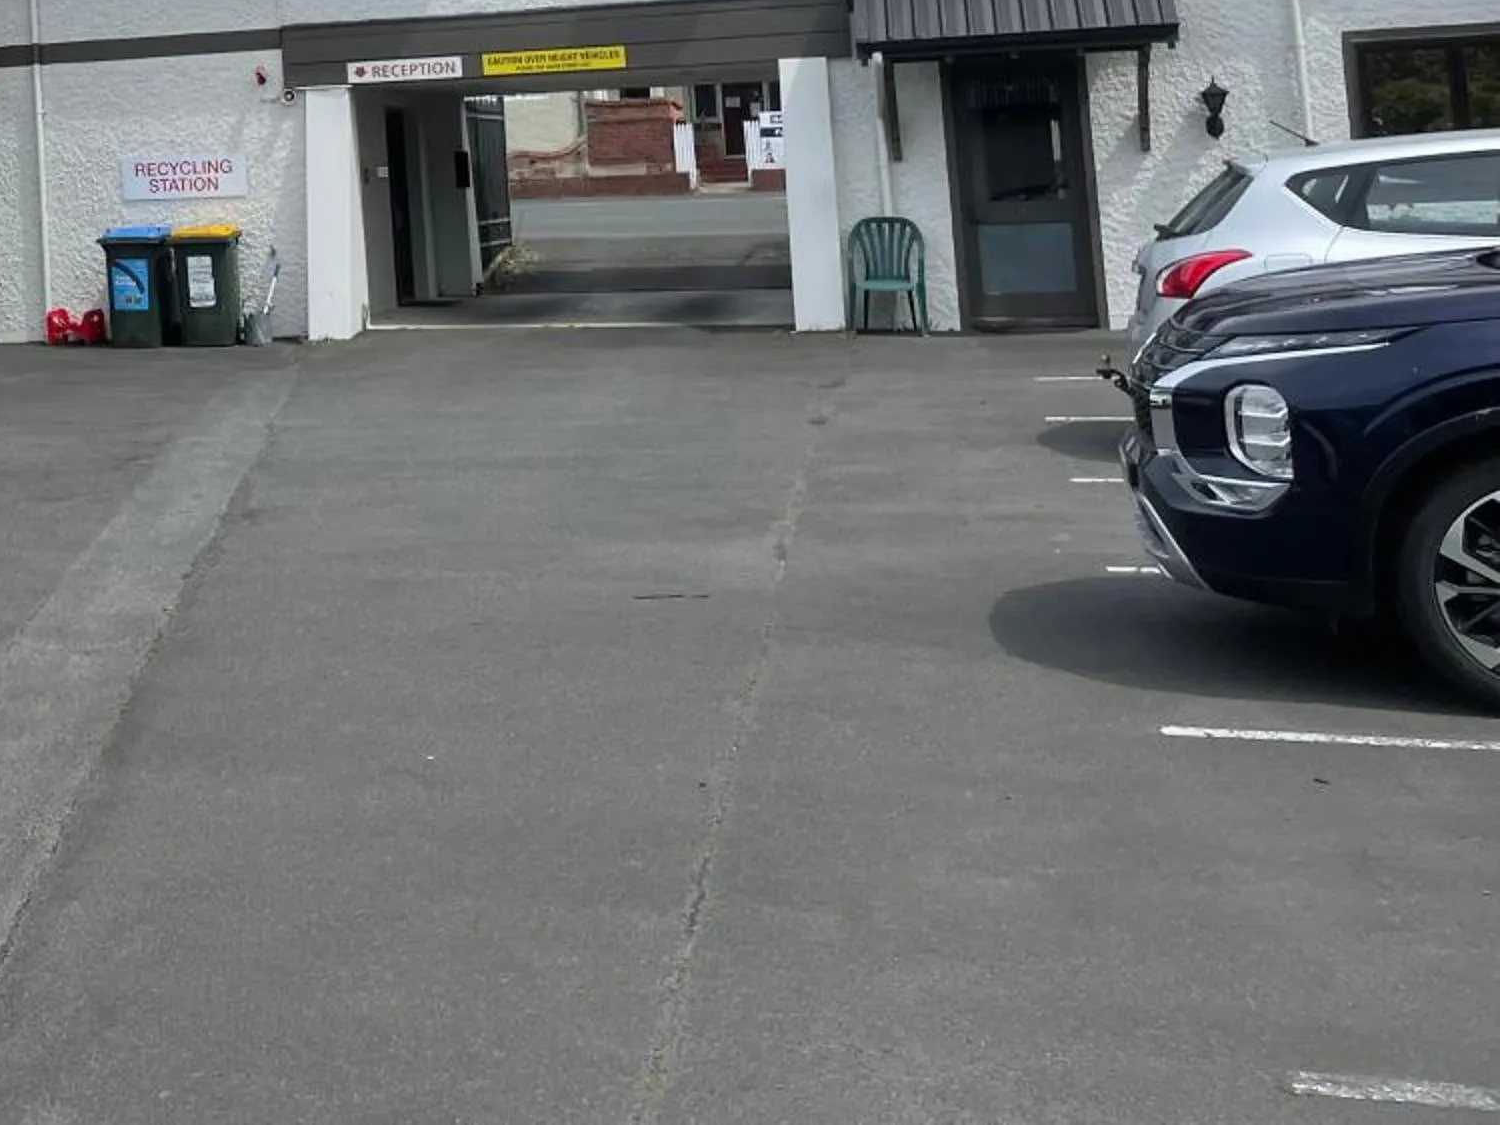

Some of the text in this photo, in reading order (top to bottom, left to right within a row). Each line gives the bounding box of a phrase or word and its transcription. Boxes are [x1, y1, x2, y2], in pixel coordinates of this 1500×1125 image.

[487, 56, 523, 66] CAUTION
[523, 54, 547, 64] OVER
[579, 50, 620, 61] VEHICLES
[371, 61, 456, 78] RECEPTION
[133, 159, 233, 177] RECYCLING
[149, 177, 219, 193] STATION
